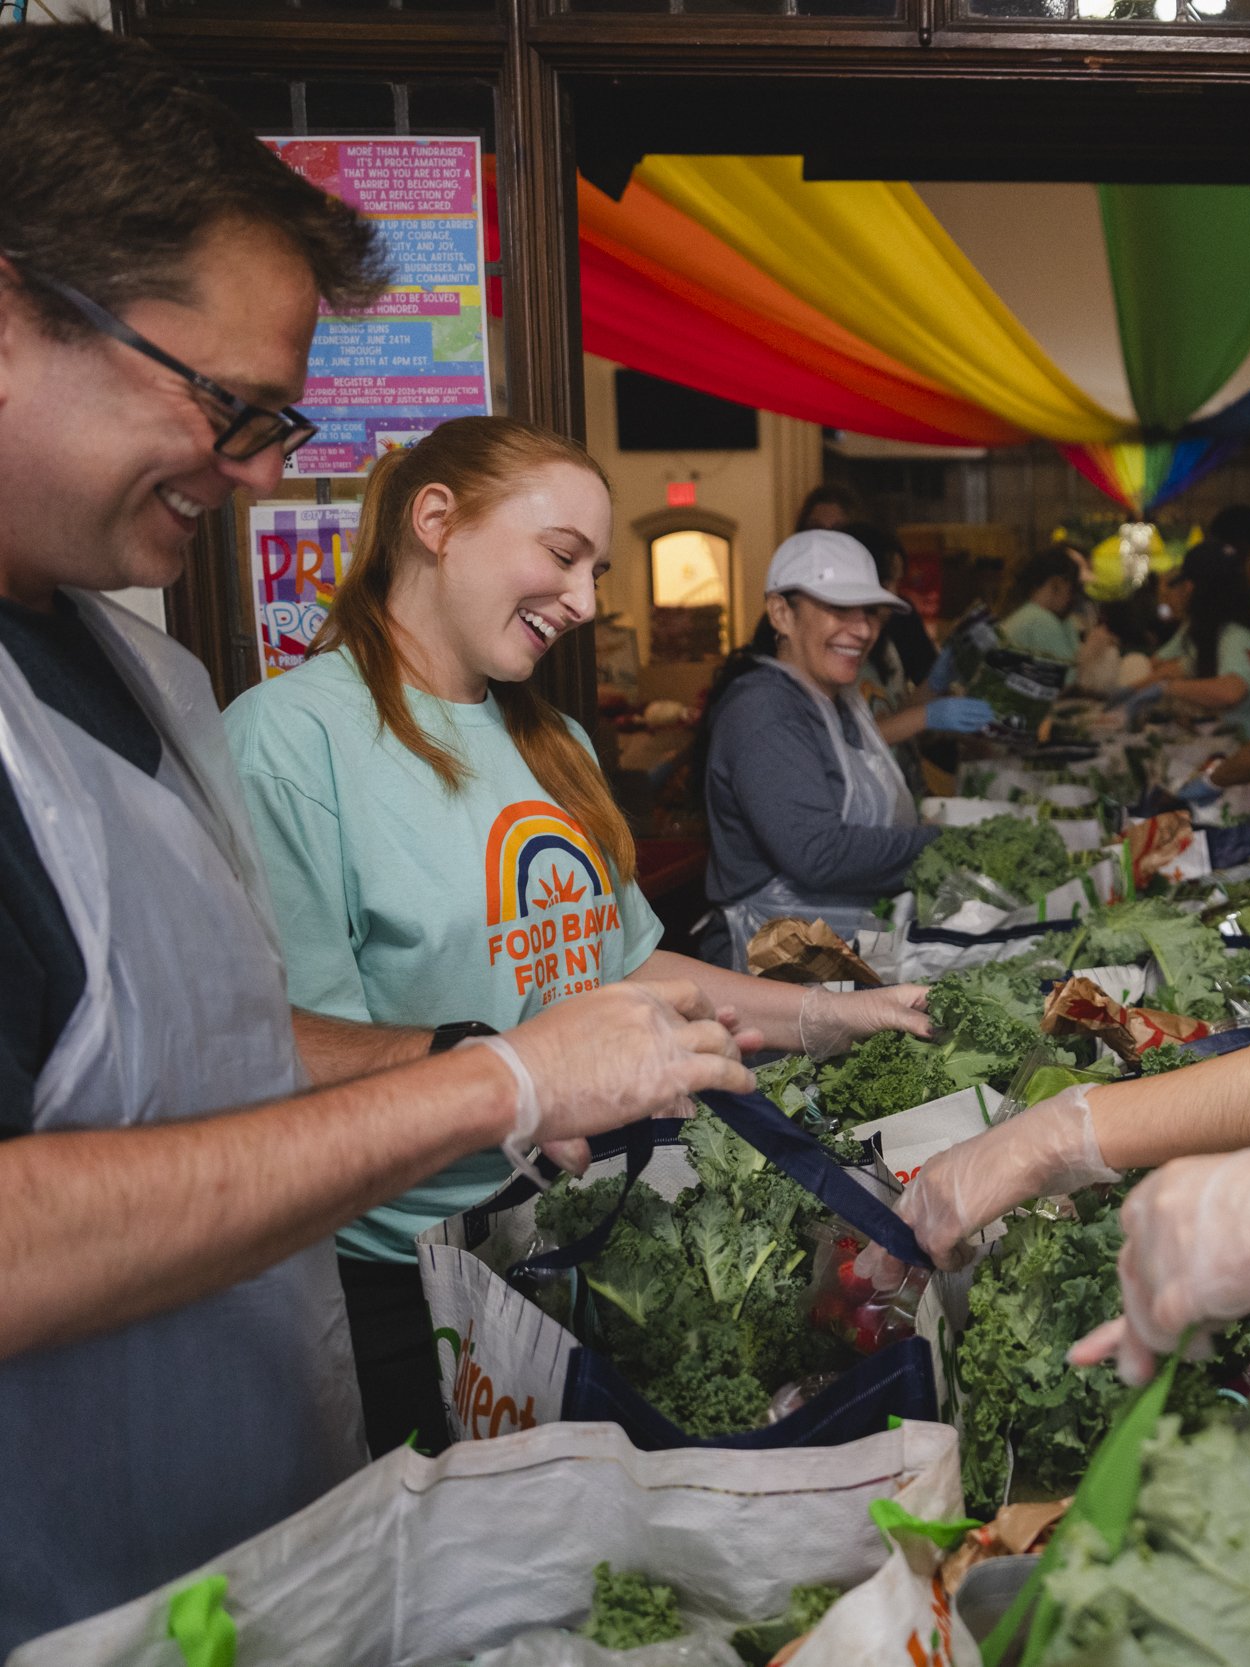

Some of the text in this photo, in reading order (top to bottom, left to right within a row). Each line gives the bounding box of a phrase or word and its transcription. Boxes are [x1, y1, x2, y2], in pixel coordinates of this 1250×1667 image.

[347, 147, 466, 157] MORE THAN A FUNDRAISER,
[356, 158, 457, 167] IT'S A PROCLAMATION!
[344, 169, 471, 178] THAT WHO YOU ARE IS NOT A
[354, 180, 461, 190] BARRIER TO BELONGING,
[360, 190, 456, 200] BUT A REFLECTION OF
[364, 201, 414, 211] SOMETHING
[388, 220, 399, 229] UP
[402, 220, 418, 229] FOR
[421, 220, 436, 229] BID
[438, 220, 474, 229] CARRIES
[392, 231, 403, 240] OF
[407, 231, 453, 241] COURAGE,
[416, 242, 434, 251] AND
[438, 242, 457, 251] JOY,
[399, 253, 427, 262] LOCAL
[431, 253, 466, 262] ARTISTS,
[404, 263, 455, 273] BUSINESSES,
[457, 263, 476, 272] AND
[395, 293, 406, 303] TO
[409, 293, 420, 303] BE
[422, 293, 458, 304] SOLVED,
[377, 304, 421, 314] HONORED.
[329, 324, 390, 334] BIDDING RUNS
[367, 335, 386, 344] JUNE
[389, 335, 411, 344] 24TH
[340, 345, 382, 355] THROUGH
[331, 357, 351, 366] JUNE
[354, 357, 376, 366] 28TH
[379, 357, 388, 366] AT
[391, 356, 411, 365] 4PM
[333, 377, 387, 387] REGISTER AT
[335, 396, 349, 405] OUR
[350, 396, 382, 404] MINISTRY
[384, 396, 394, 404] OF
[396, 396, 423, 404] JUSTICE
[425, 396, 440, 404] AND
[261, 530, 350, 604] PRI
[268, 655, 276, 667] A
[488, 919, 557, 967] FOOD
[514, 953, 560, 996] FOR
[564, 977, 600, 996] 1983
